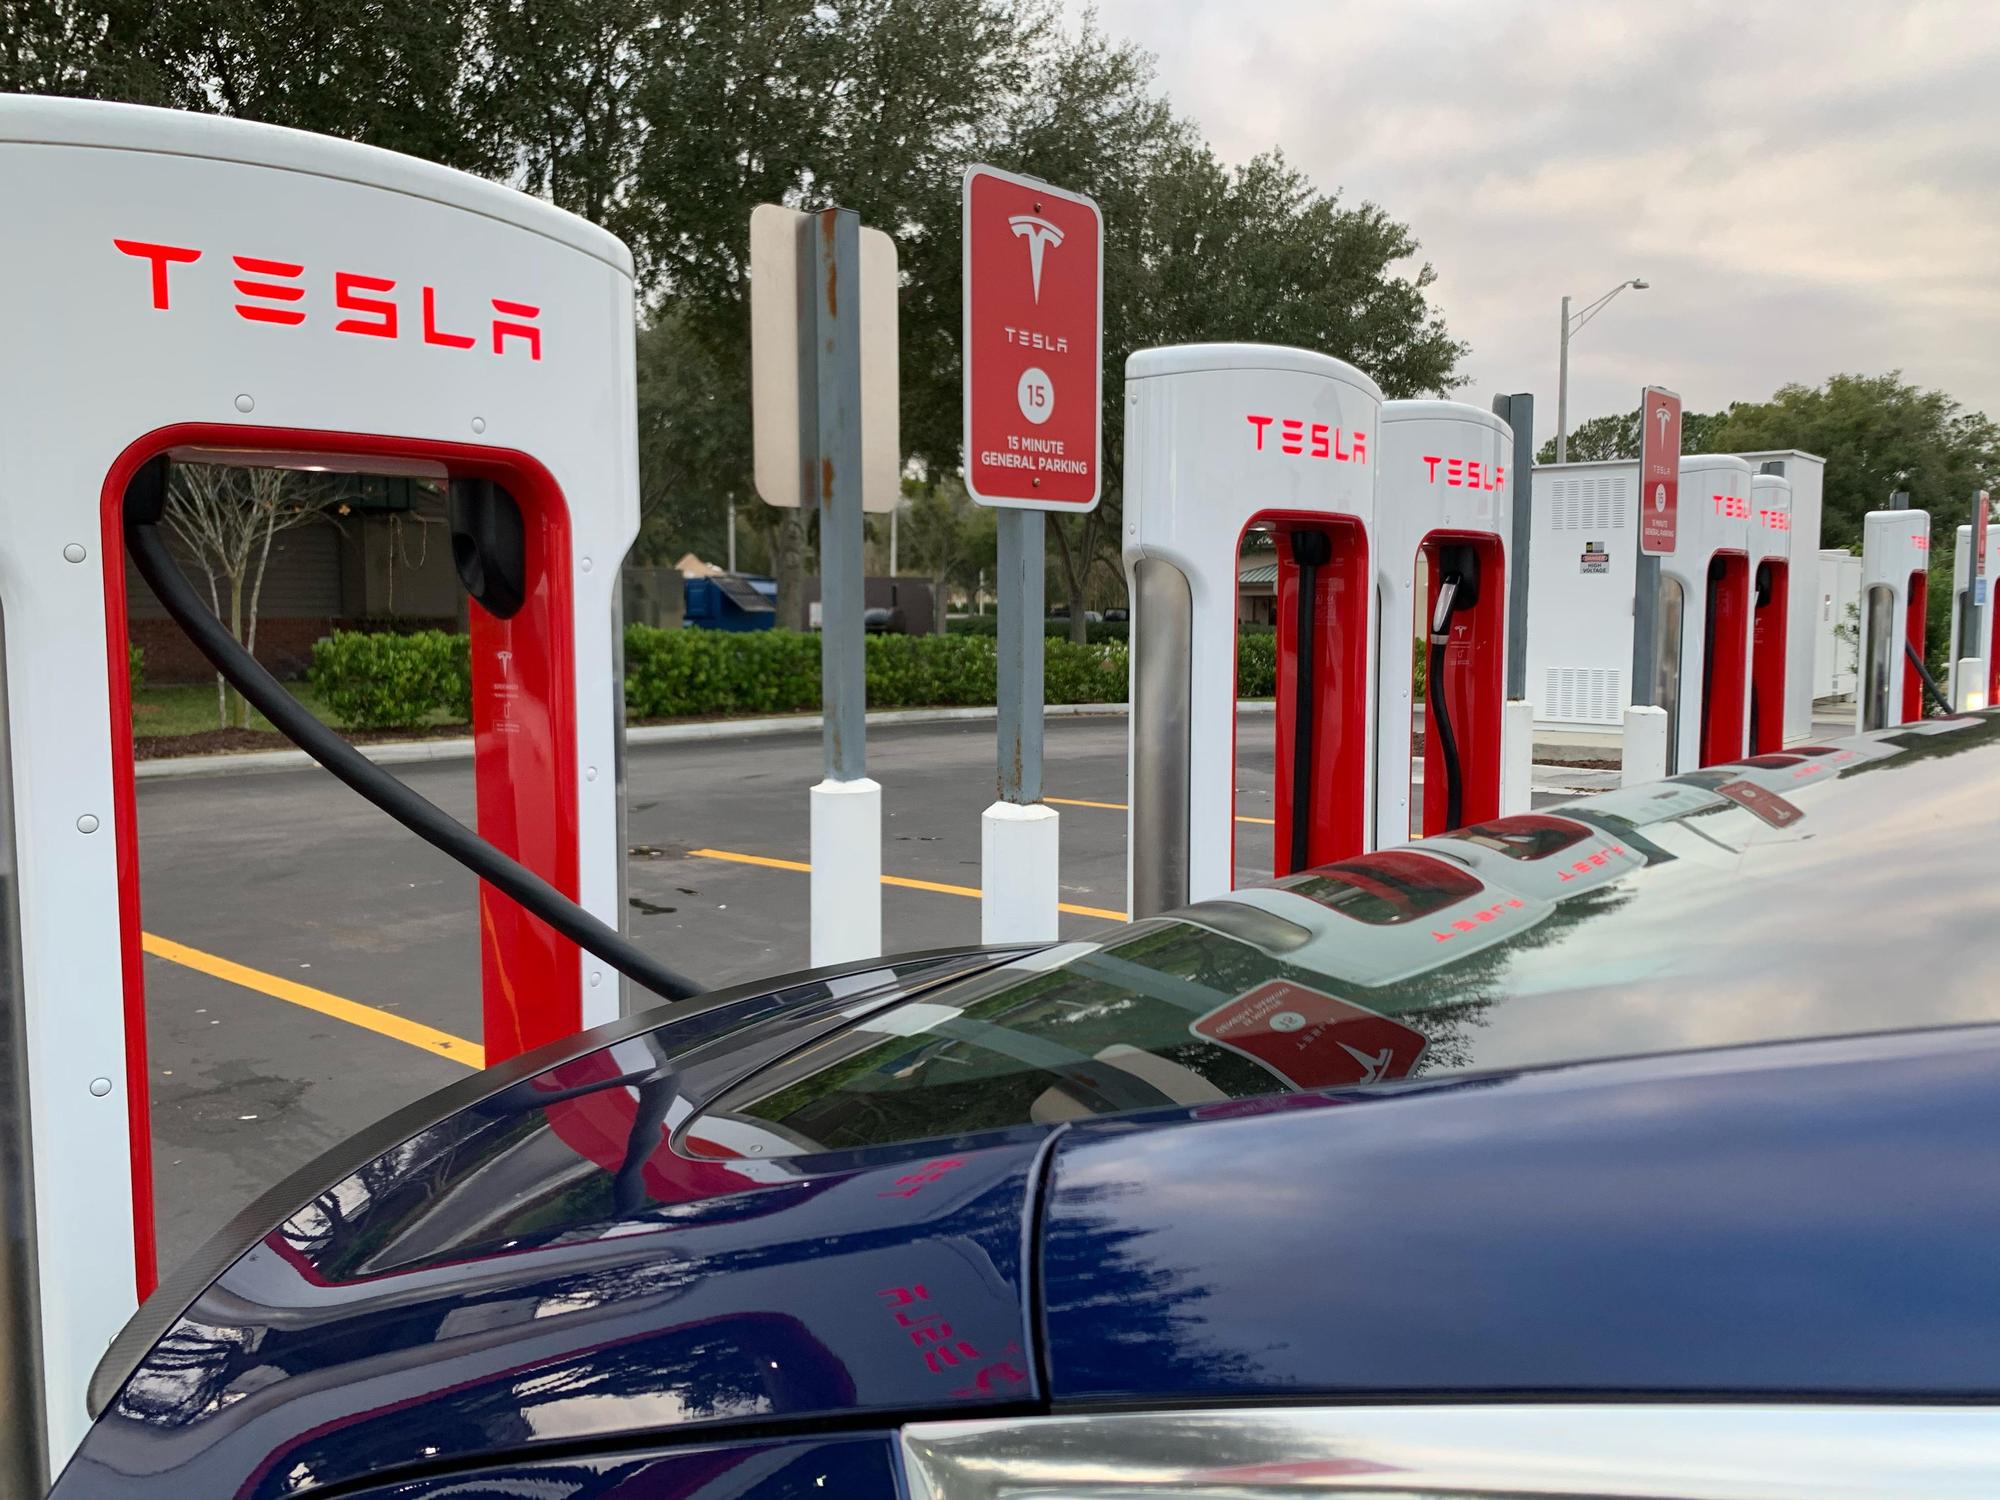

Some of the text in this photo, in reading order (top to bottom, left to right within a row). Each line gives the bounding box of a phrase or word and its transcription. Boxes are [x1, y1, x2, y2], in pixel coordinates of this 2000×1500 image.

[112, 239, 542, 362] TESLA
[1004, 326, 1068, 354] TESLA
[1027, 384, 1045, 407] 15
[1007, 436, 1065, 455] 15 MINUTE
[1246, 415, 1367, 464] TESLA
[981, 451, 1088, 475] GENERAL PARKING
[1423, 455, 1505, 491] TESLA
[1712, 495, 1751, 520] TESL
[1759, 509, 1792, 531] TESL
